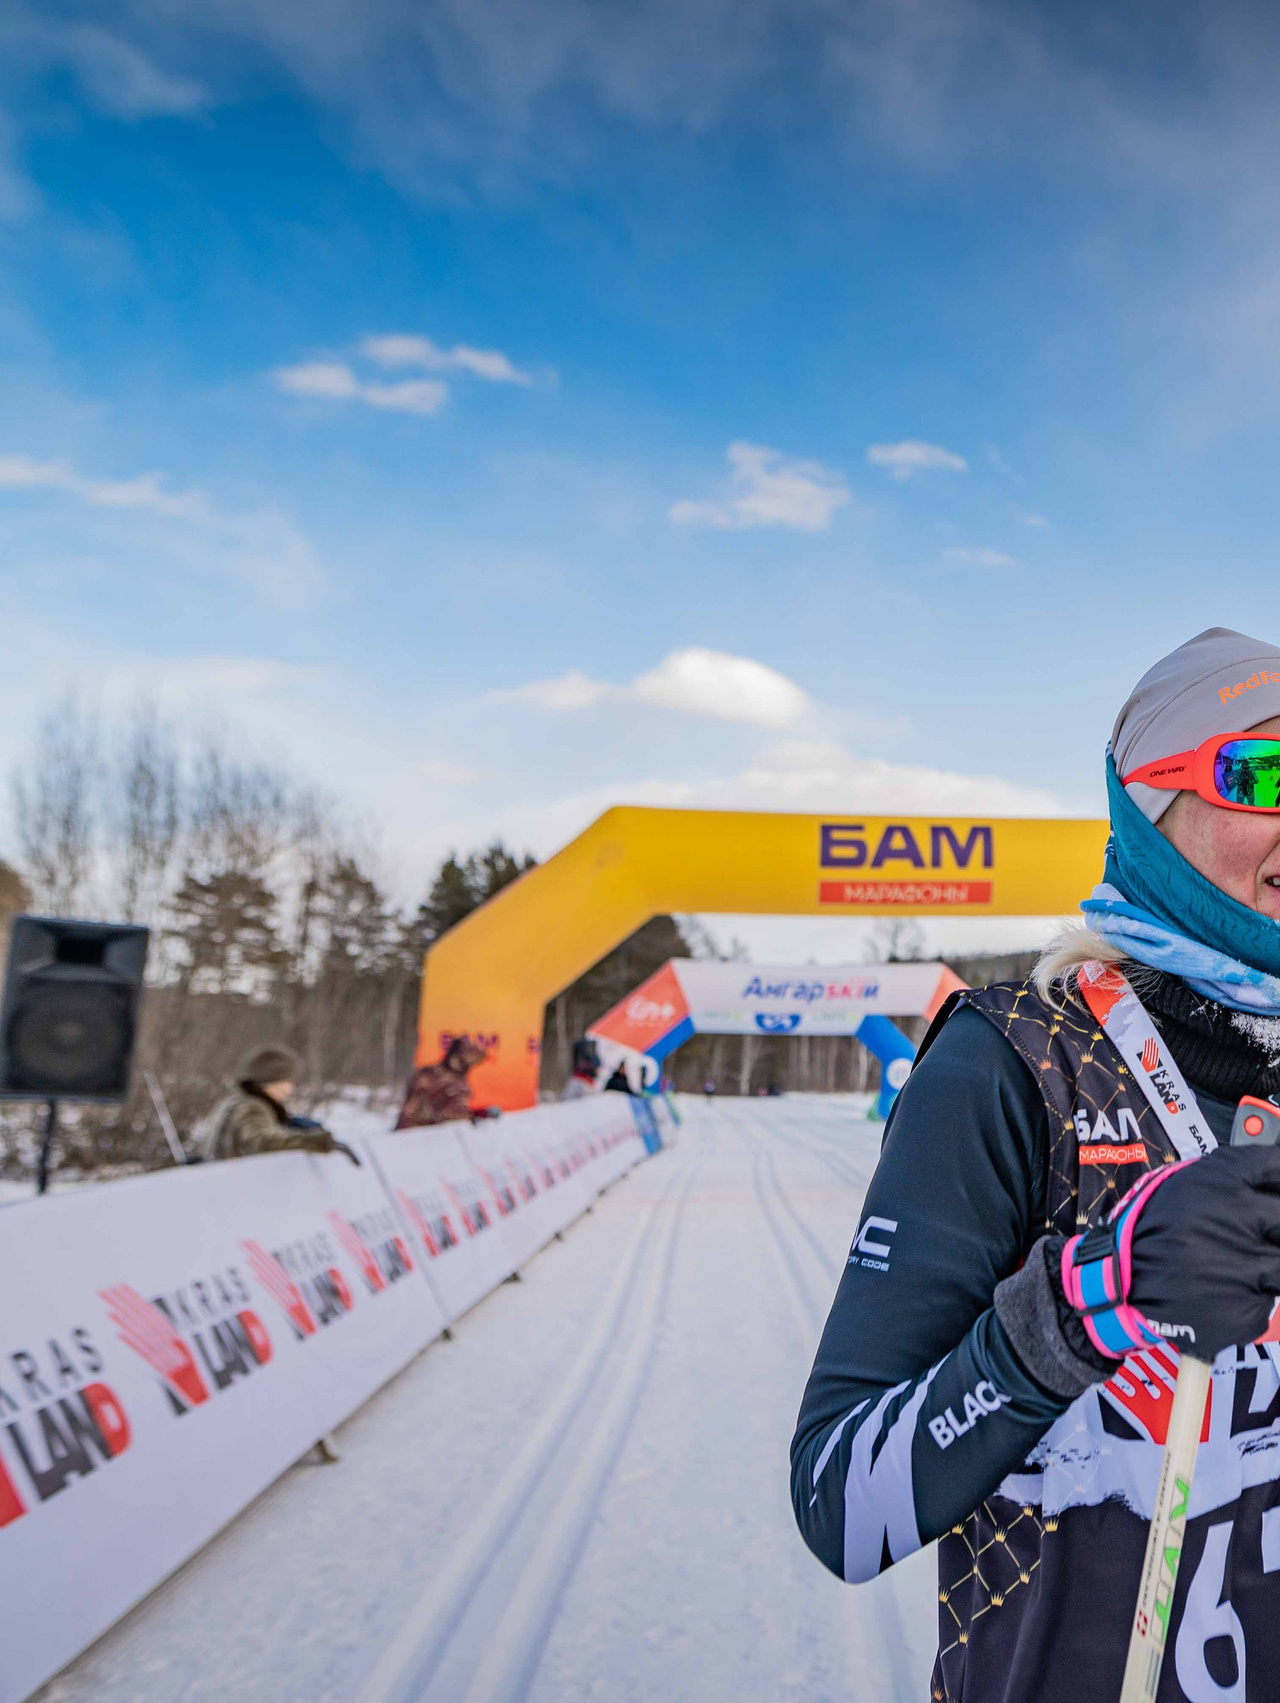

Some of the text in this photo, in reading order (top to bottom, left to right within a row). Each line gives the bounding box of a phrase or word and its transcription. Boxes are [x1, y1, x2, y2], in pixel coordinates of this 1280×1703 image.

[819, 824, 994, 868] БАМ
[1149, 1072, 1179, 1115] LAND
[1160, 1069, 1187, 1112] KRAS
[193, 1308, 274, 1391] LAND
[5, 1382, 132, 1503] LAND
